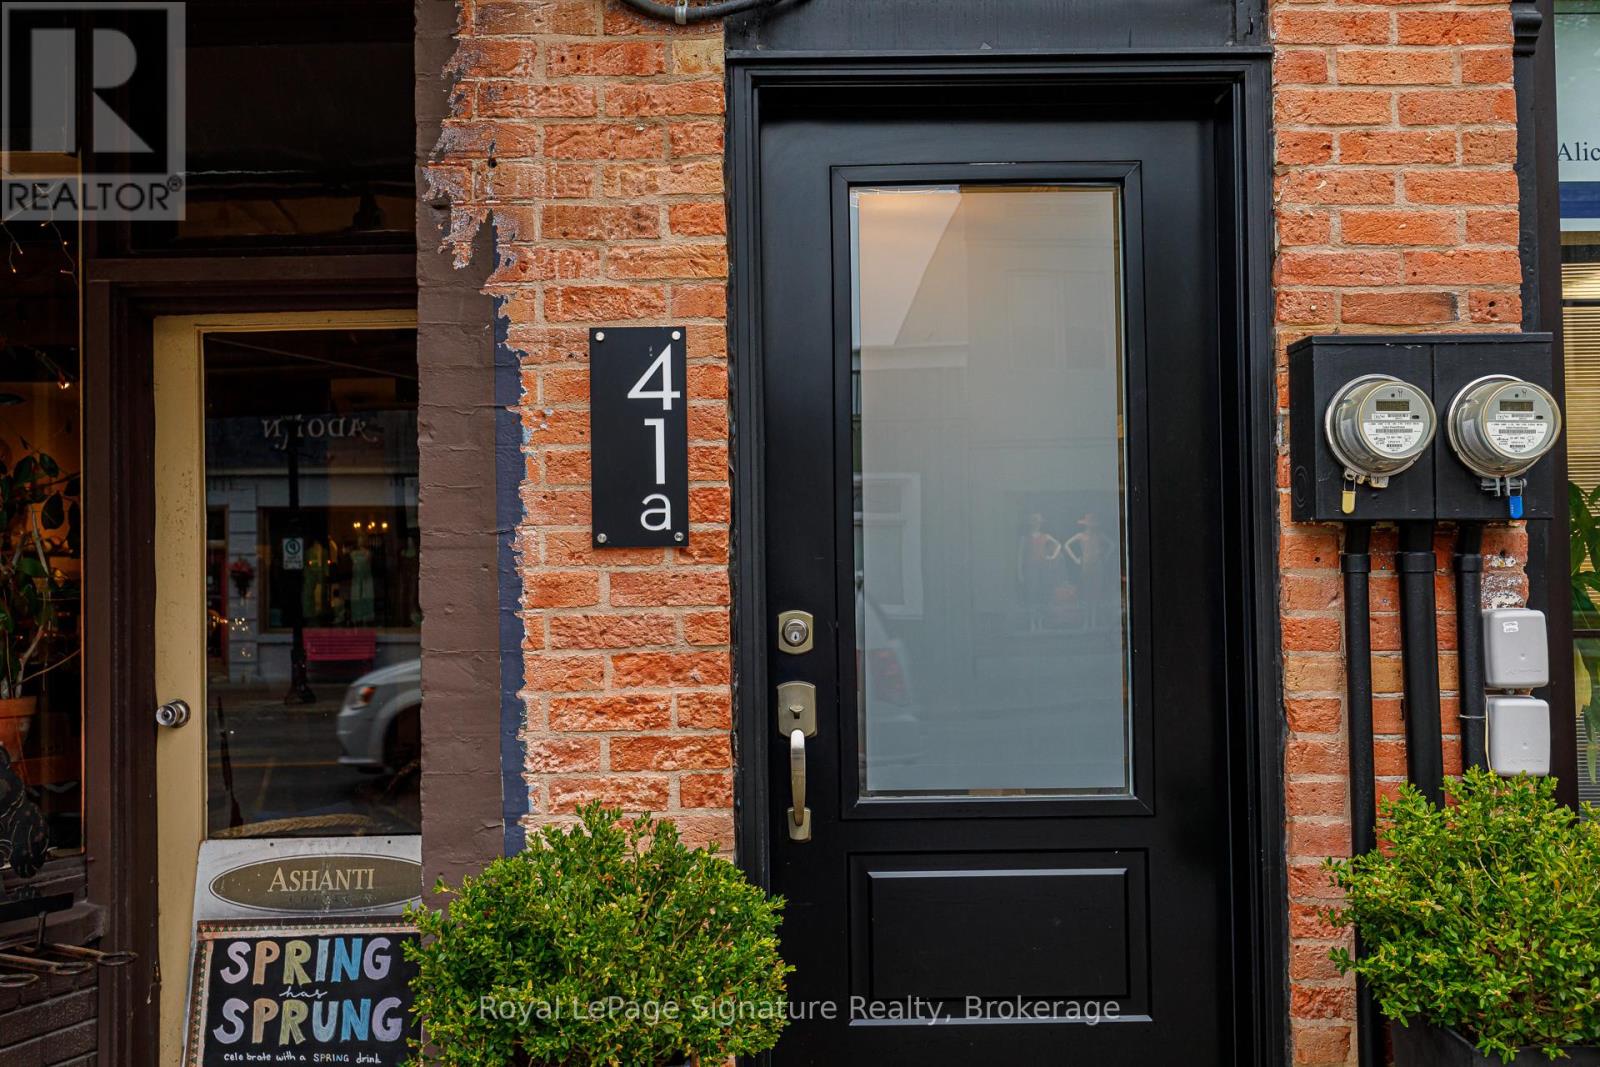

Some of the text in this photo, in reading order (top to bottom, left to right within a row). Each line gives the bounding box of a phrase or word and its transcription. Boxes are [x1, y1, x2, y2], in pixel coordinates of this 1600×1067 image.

[220, 937, 391, 985] SPRING
[279, 985, 328, 999] has
[213, 997, 402, 1046] SPRUNG
[275, 1050, 296, 1061] with
[300, 1054, 306, 1062] a
[313, 1053, 350, 1063] SPRING
